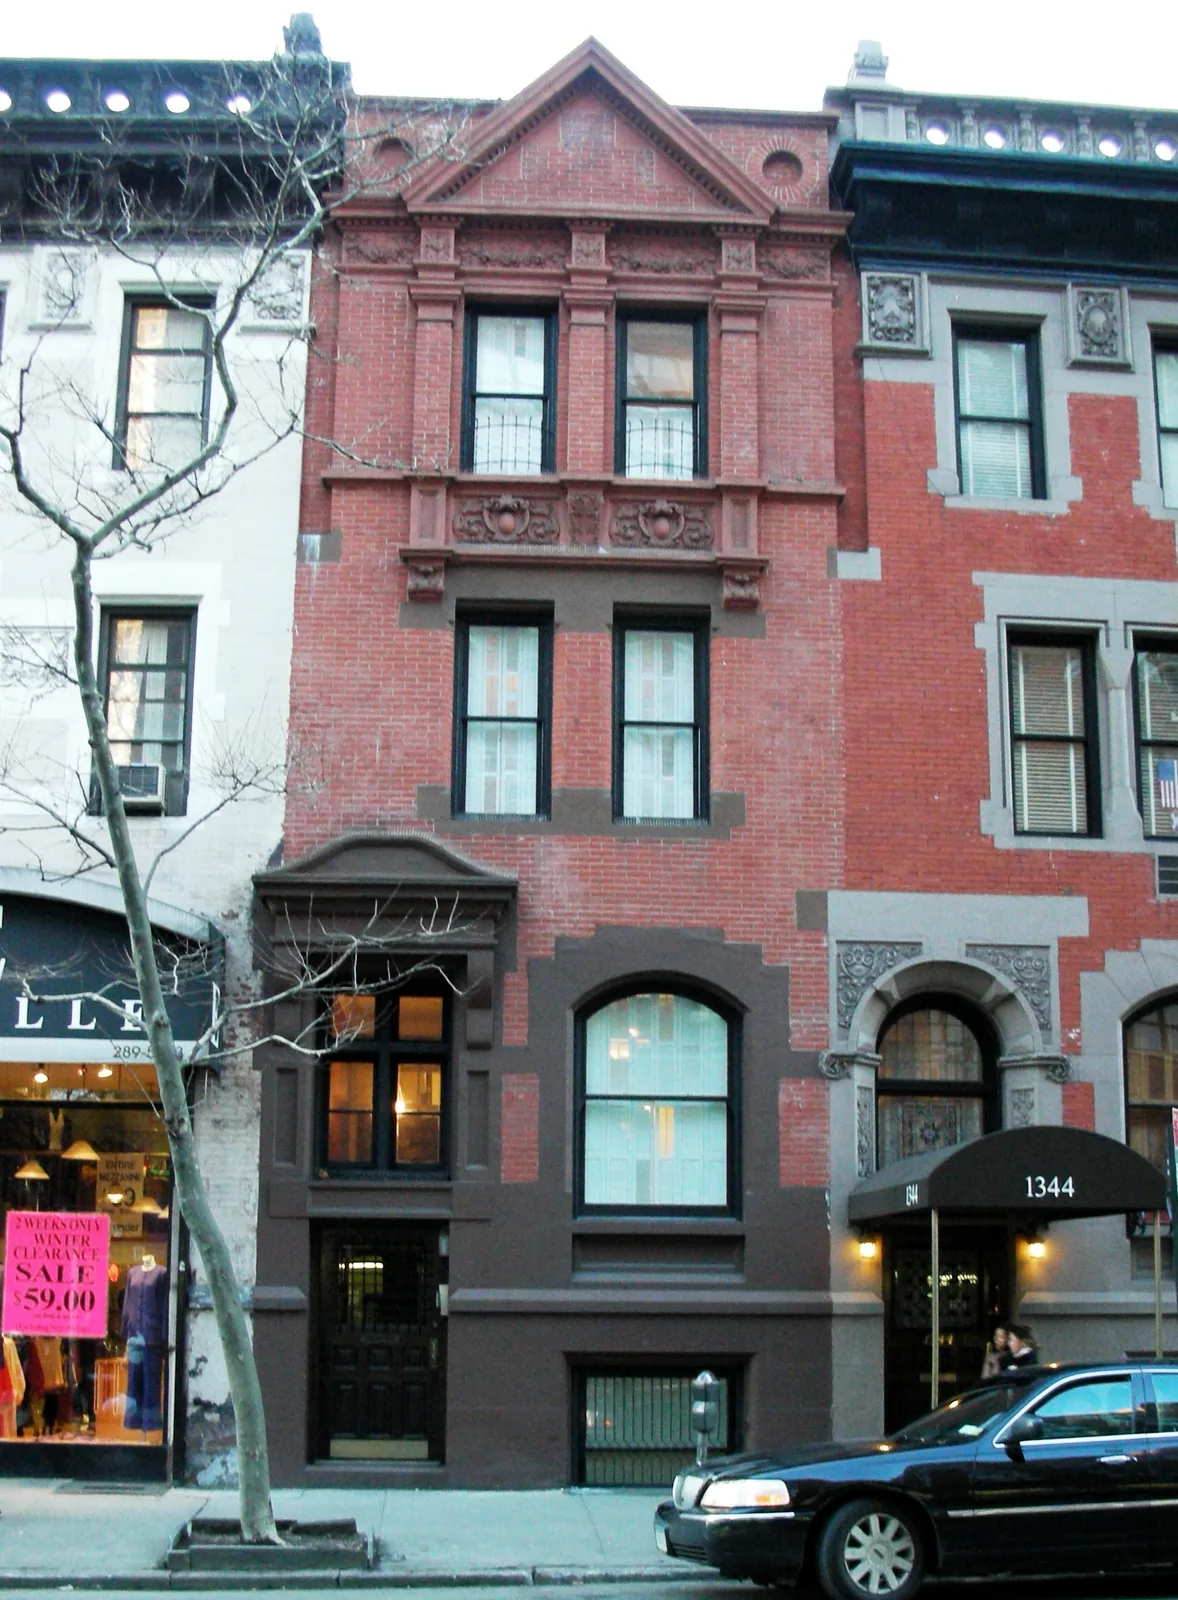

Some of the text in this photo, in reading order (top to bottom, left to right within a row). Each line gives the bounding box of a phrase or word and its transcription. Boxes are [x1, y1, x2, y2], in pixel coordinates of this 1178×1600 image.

[905, 1184, 918, 1207] 1344
[1025, 1175, 1075, 1198] 1344
[15, 1217, 101, 1232] 2 WEEKS ONLY
[34, 1233, 91, 1248] WINTER
[13, 1246, 100, 1262] CLEARANCE
[15, 1262, 95, 1285] SALE
[13, 1287, 96, 1313] $59.00
